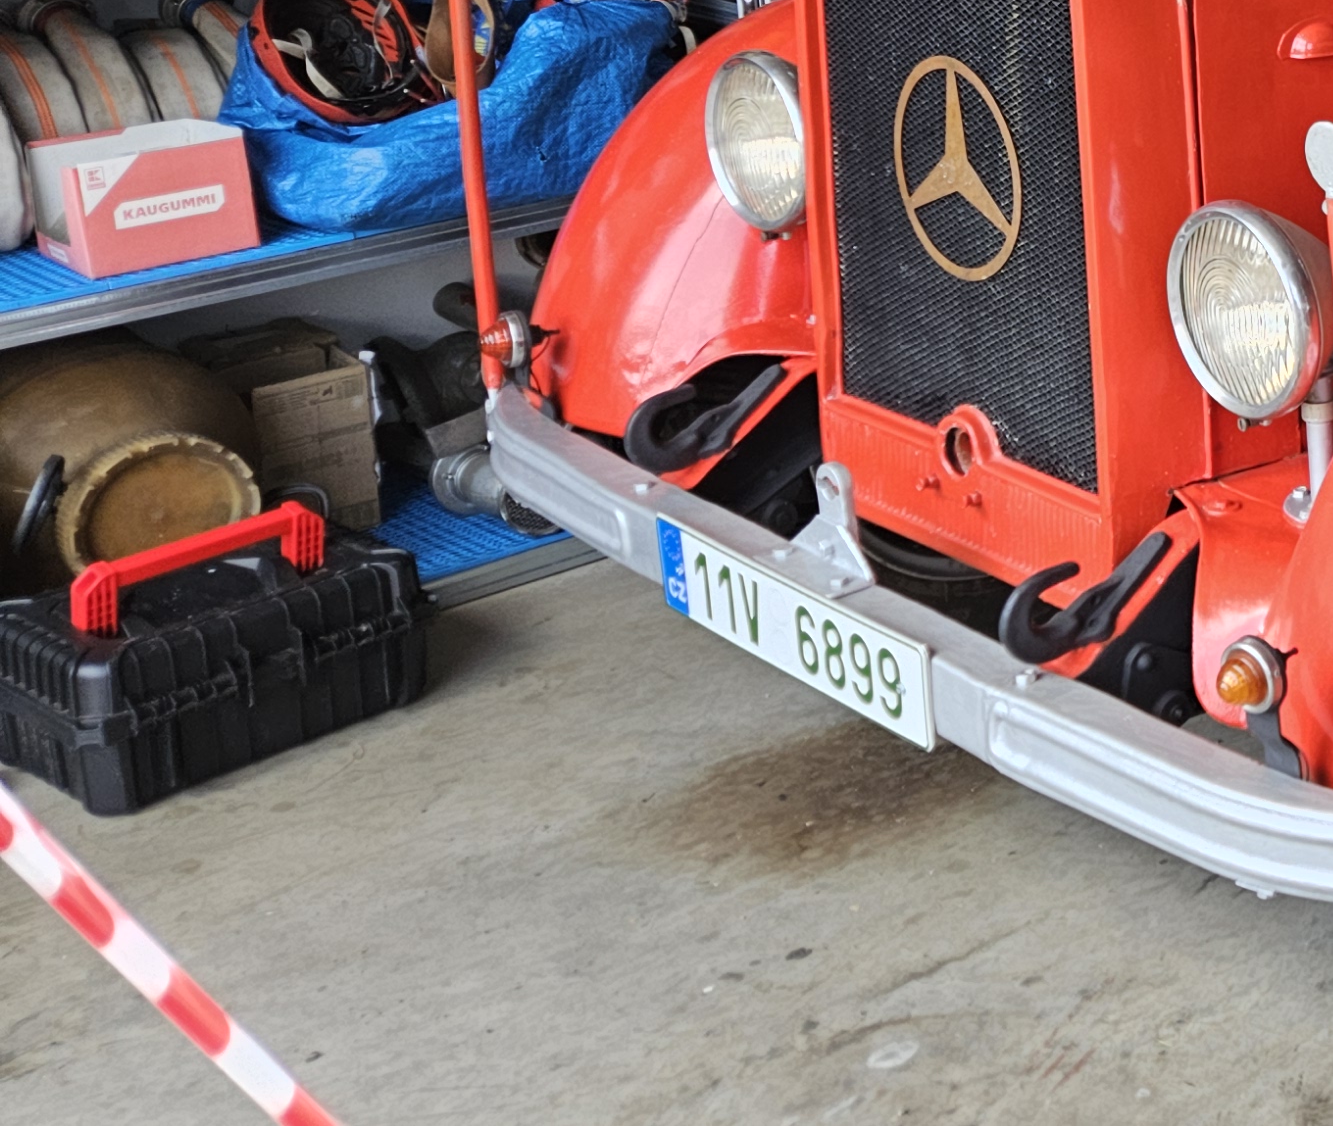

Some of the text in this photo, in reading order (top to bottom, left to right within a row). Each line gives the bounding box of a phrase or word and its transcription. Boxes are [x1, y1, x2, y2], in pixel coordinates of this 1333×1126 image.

[122, 193, 217, 221] KAUGUMMI
[668, 576, 688, 604] CZ
[694, 552, 904, 720] 11V 6899
